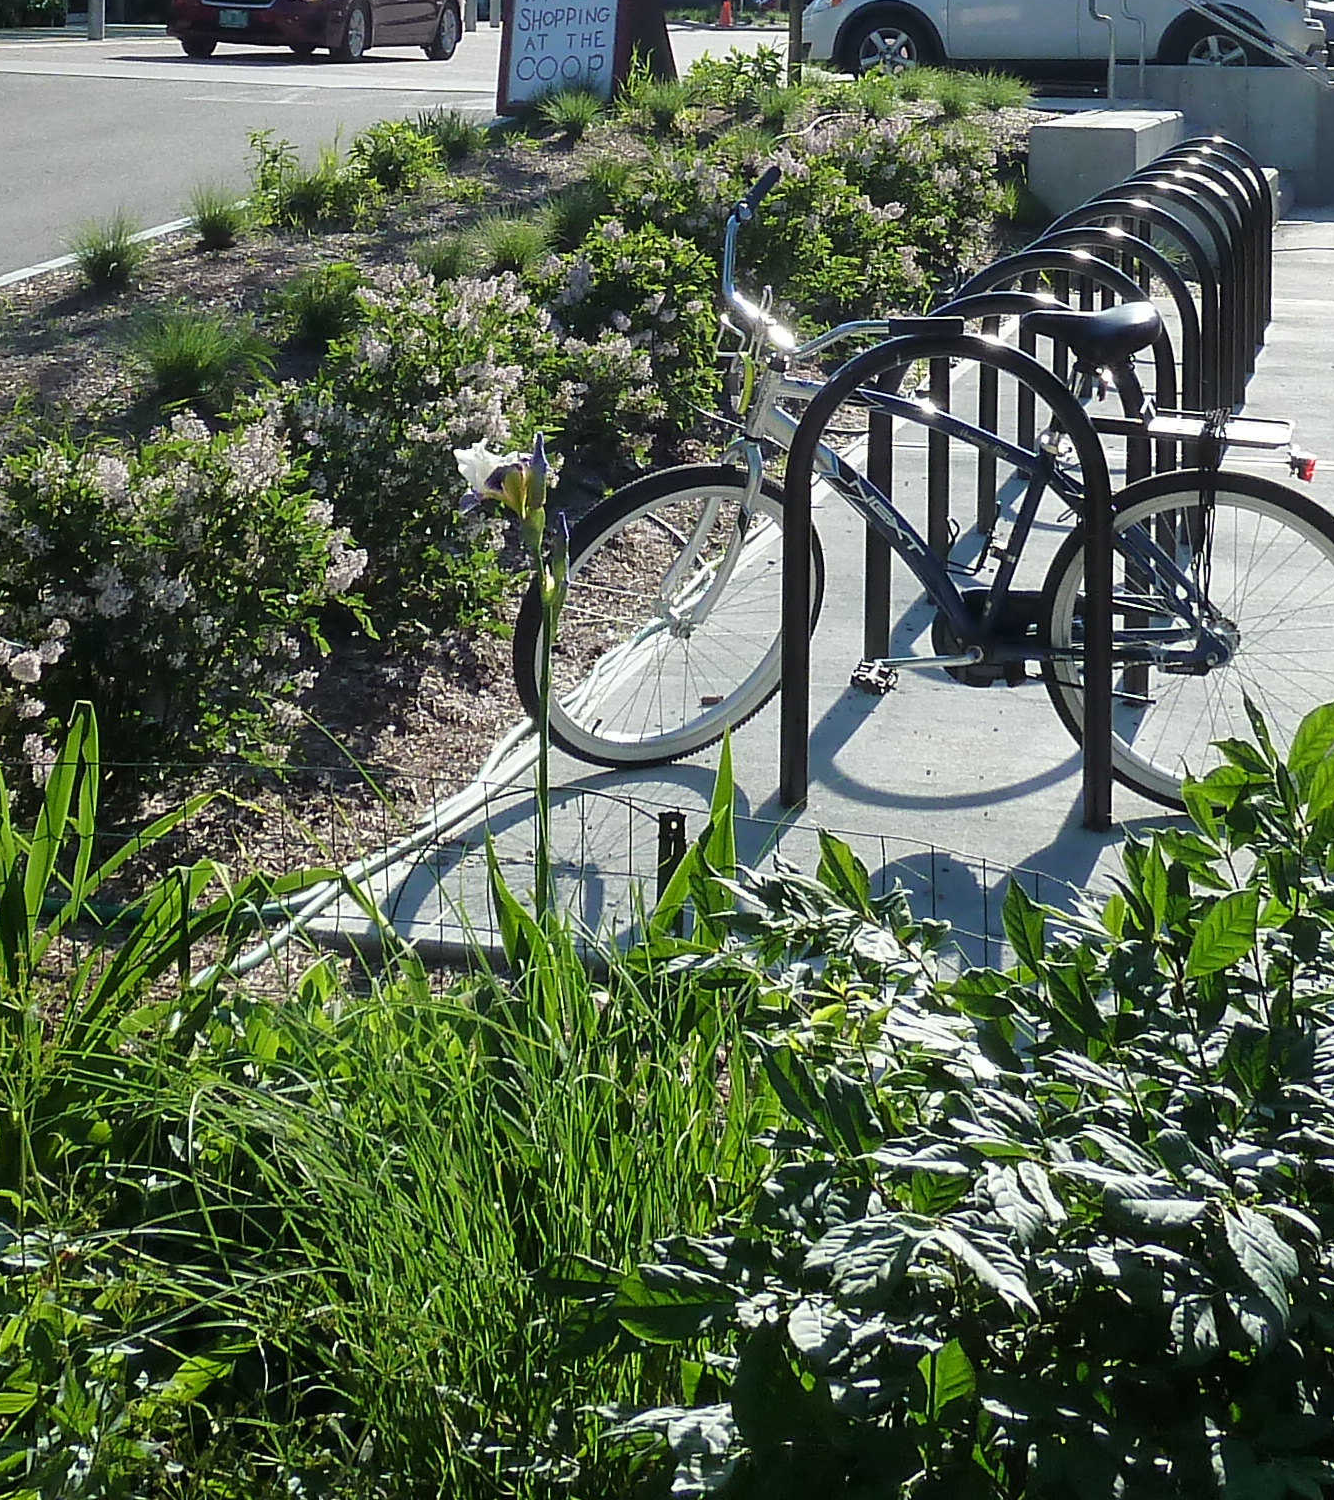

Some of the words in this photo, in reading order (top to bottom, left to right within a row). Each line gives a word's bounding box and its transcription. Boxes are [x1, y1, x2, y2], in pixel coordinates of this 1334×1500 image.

[517, 6, 611, 32] SHOPPING
[523, 33, 549, 52] AT
[566, 30, 606, 49] THE
[515, 53, 605, 82] COOP
[844, 478, 927, 557] NEXT
